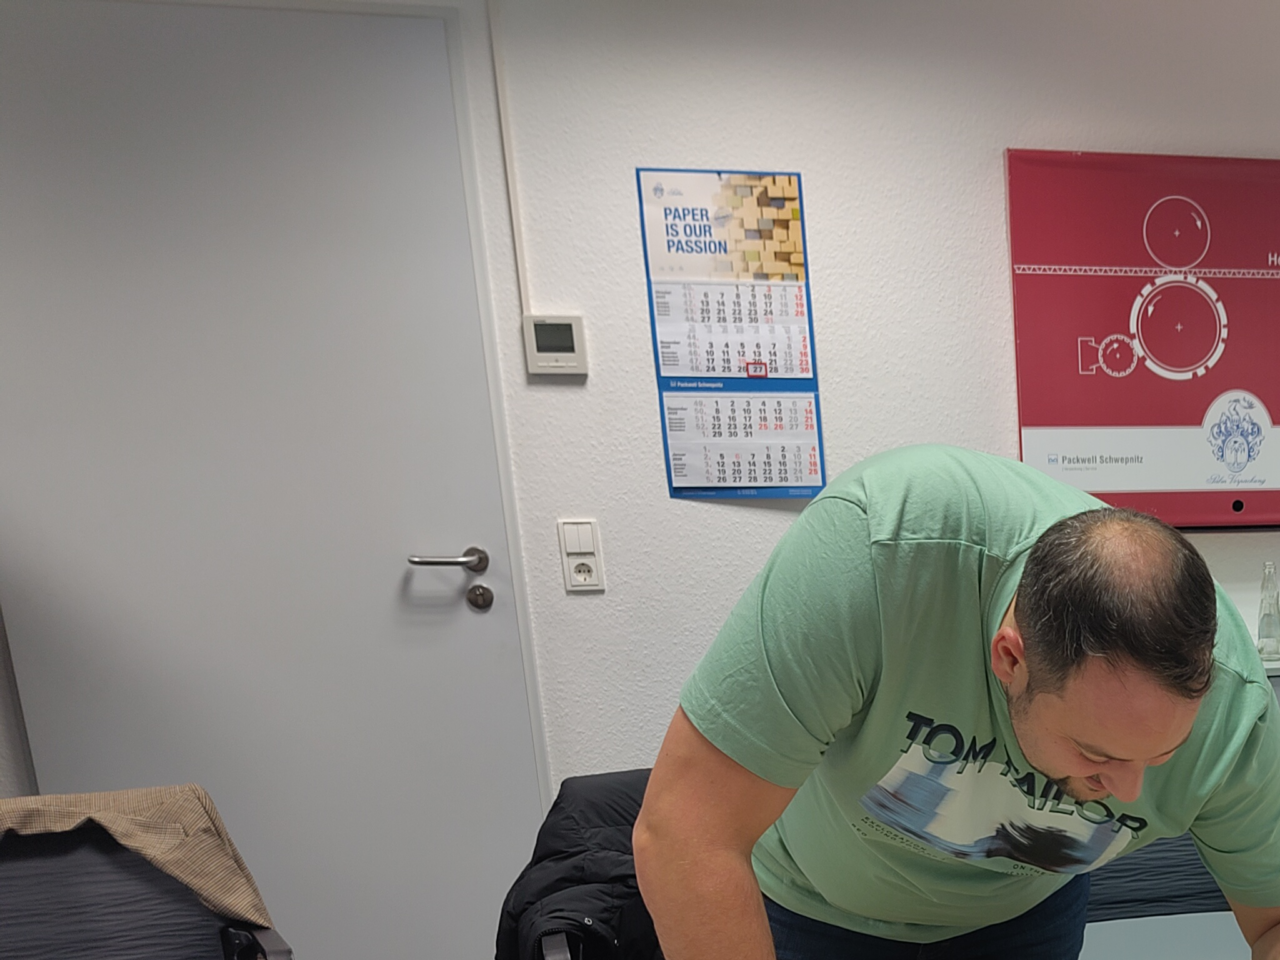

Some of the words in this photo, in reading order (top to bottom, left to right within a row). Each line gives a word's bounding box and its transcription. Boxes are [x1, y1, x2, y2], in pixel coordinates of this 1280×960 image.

[664, 207, 710, 222] PAPER
[665, 223, 679, 237] IS
[683, 224, 713, 238] OUR
[667, 239, 728, 254] PASSION
[1062, 455, 1097, 464] Packwell
[1100, 455, 1143, 466] Schwepnitz
[901, 711, 996, 774] TOM
[864, 816, 926, 853] EXPLORATION
